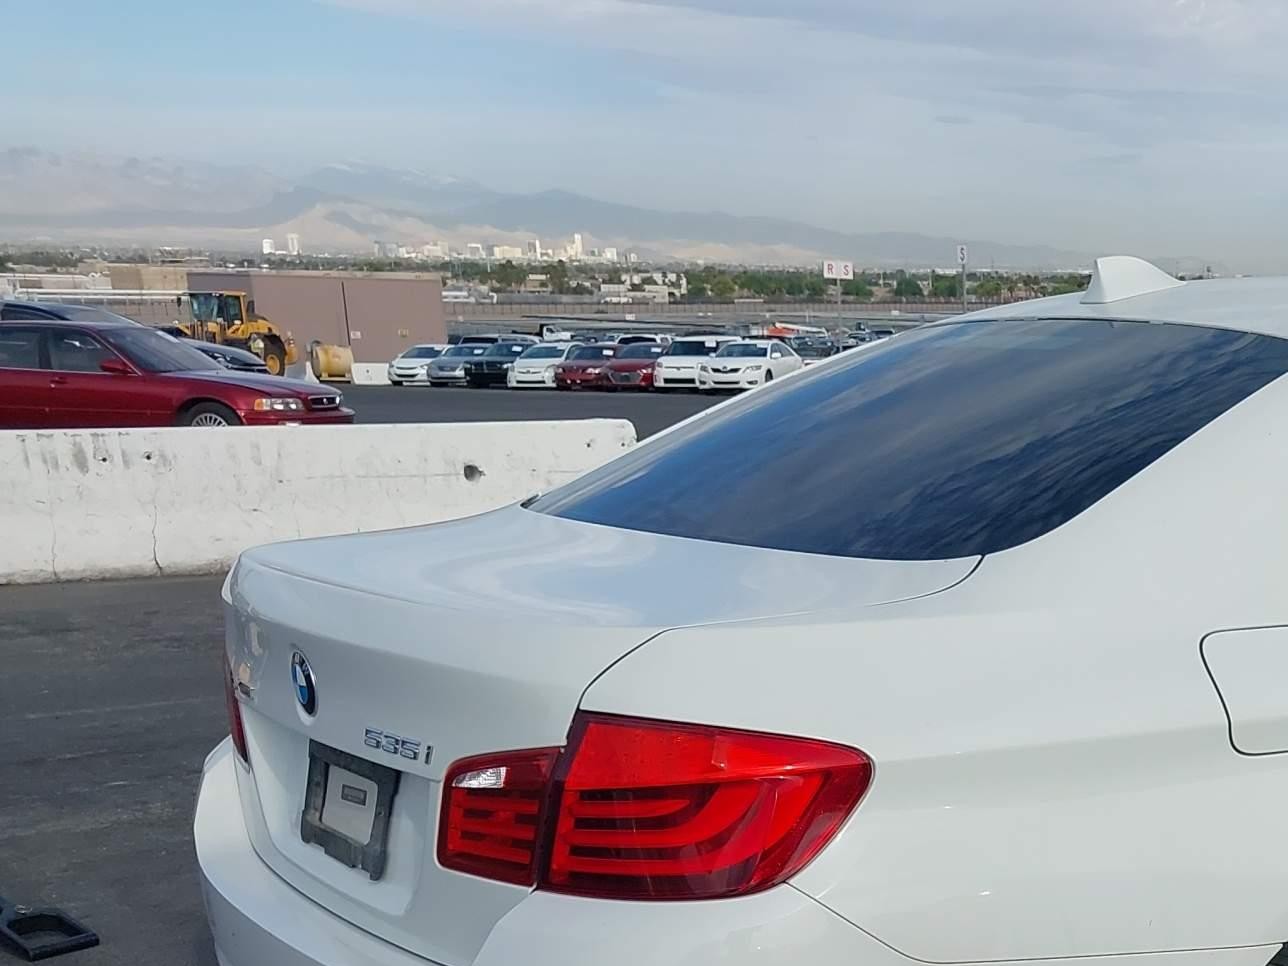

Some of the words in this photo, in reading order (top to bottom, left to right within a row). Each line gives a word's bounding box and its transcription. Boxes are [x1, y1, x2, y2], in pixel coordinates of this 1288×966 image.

[960, 247, 967, 261] S
[827, 263, 834, 275] R
[843, 264, 850, 276] S
